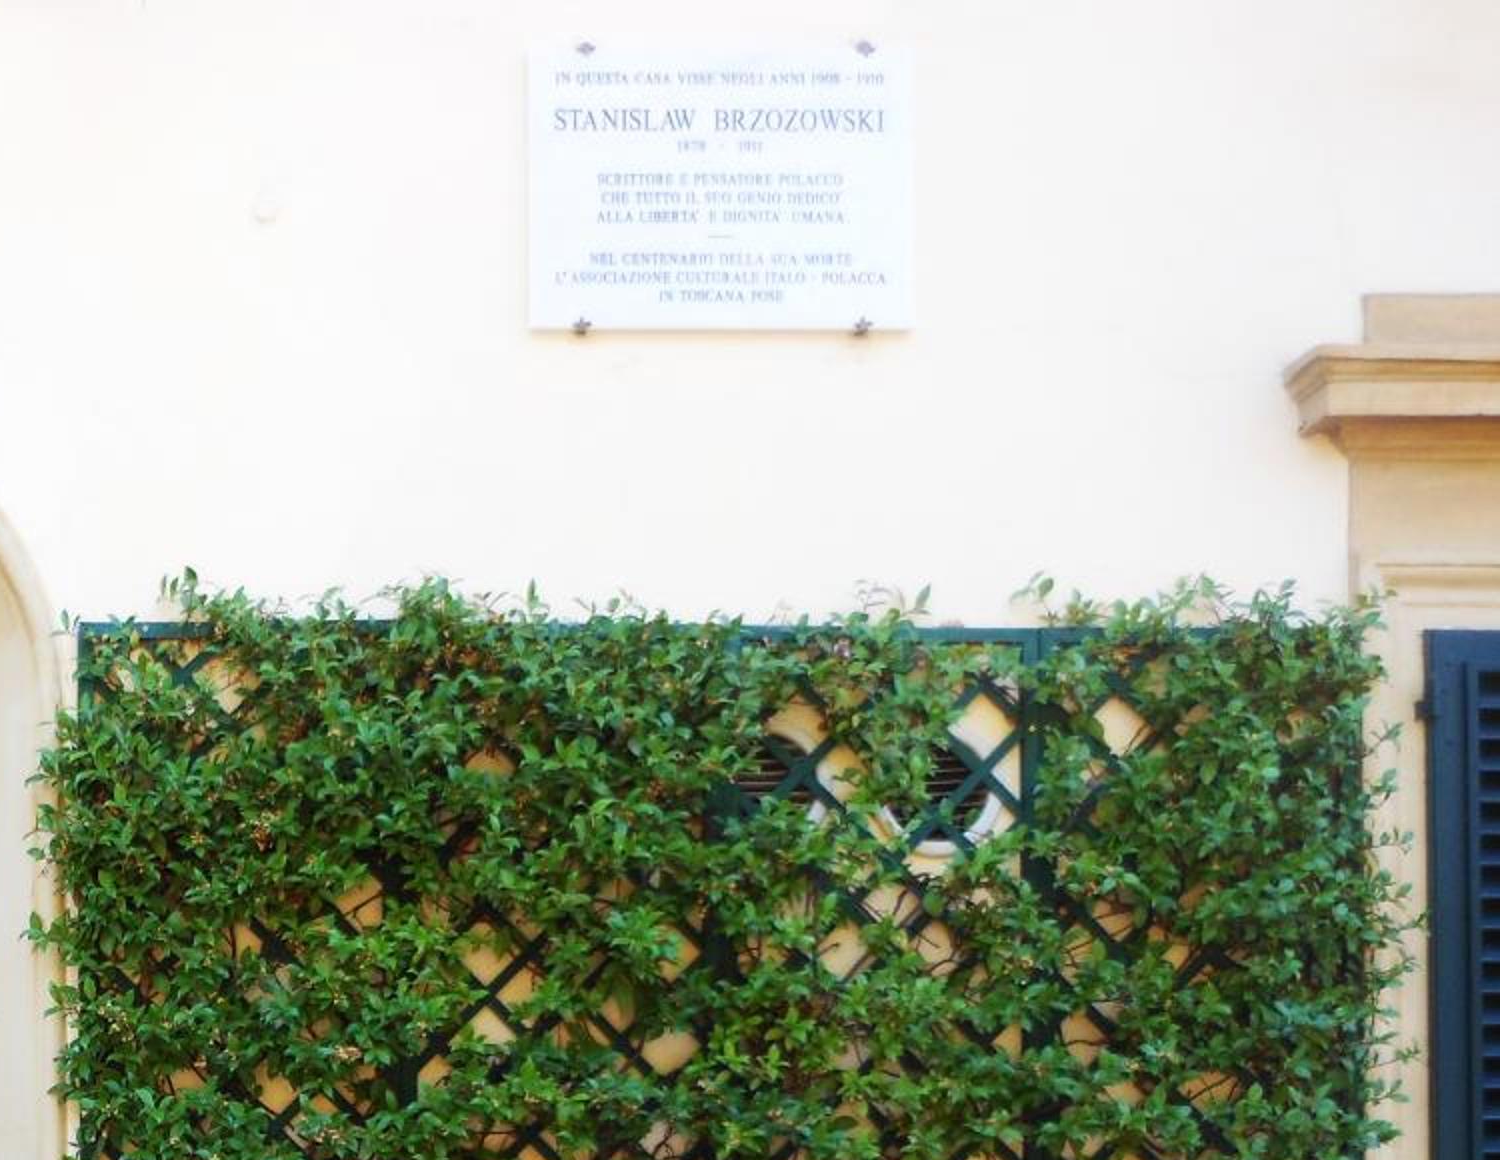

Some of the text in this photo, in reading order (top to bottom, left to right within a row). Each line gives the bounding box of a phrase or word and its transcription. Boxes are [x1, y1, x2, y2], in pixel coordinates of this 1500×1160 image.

[555, 71, 571, 86] IN
[576, 71, 628, 86] QUESTA
[633, 71, 670, 86] CASA
[720, 71, 764, 86] NEGLI
[769, 71, 806, 86] ANNI
[554, 108, 885, 132] STANISLAW BRZOZOWSKI
[596, 172, 844, 186] SCRITTORE E PENSATORE POLACCO
[600, 191, 630, 205] CHE
[635, 191, 682, 205] TUTTO
[685, 191, 699, 205] IL
[704, 191, 732, 205] SUO
[736, 191, 782, 205] GENIO
[596, 210, 633, 224] ALLA
[791, 210, 845, 224] UMANA
[589, 252, 853, 266] NEL CENTENARIO DELLA SUA MORTE
[676, 271, 759, 286] CULTURALE
[764, 271, 806, 286] ITALO
[821, 271, 887, 286] POLACCA
[658, 289, 785, 303] IN TOSCANA POSE
